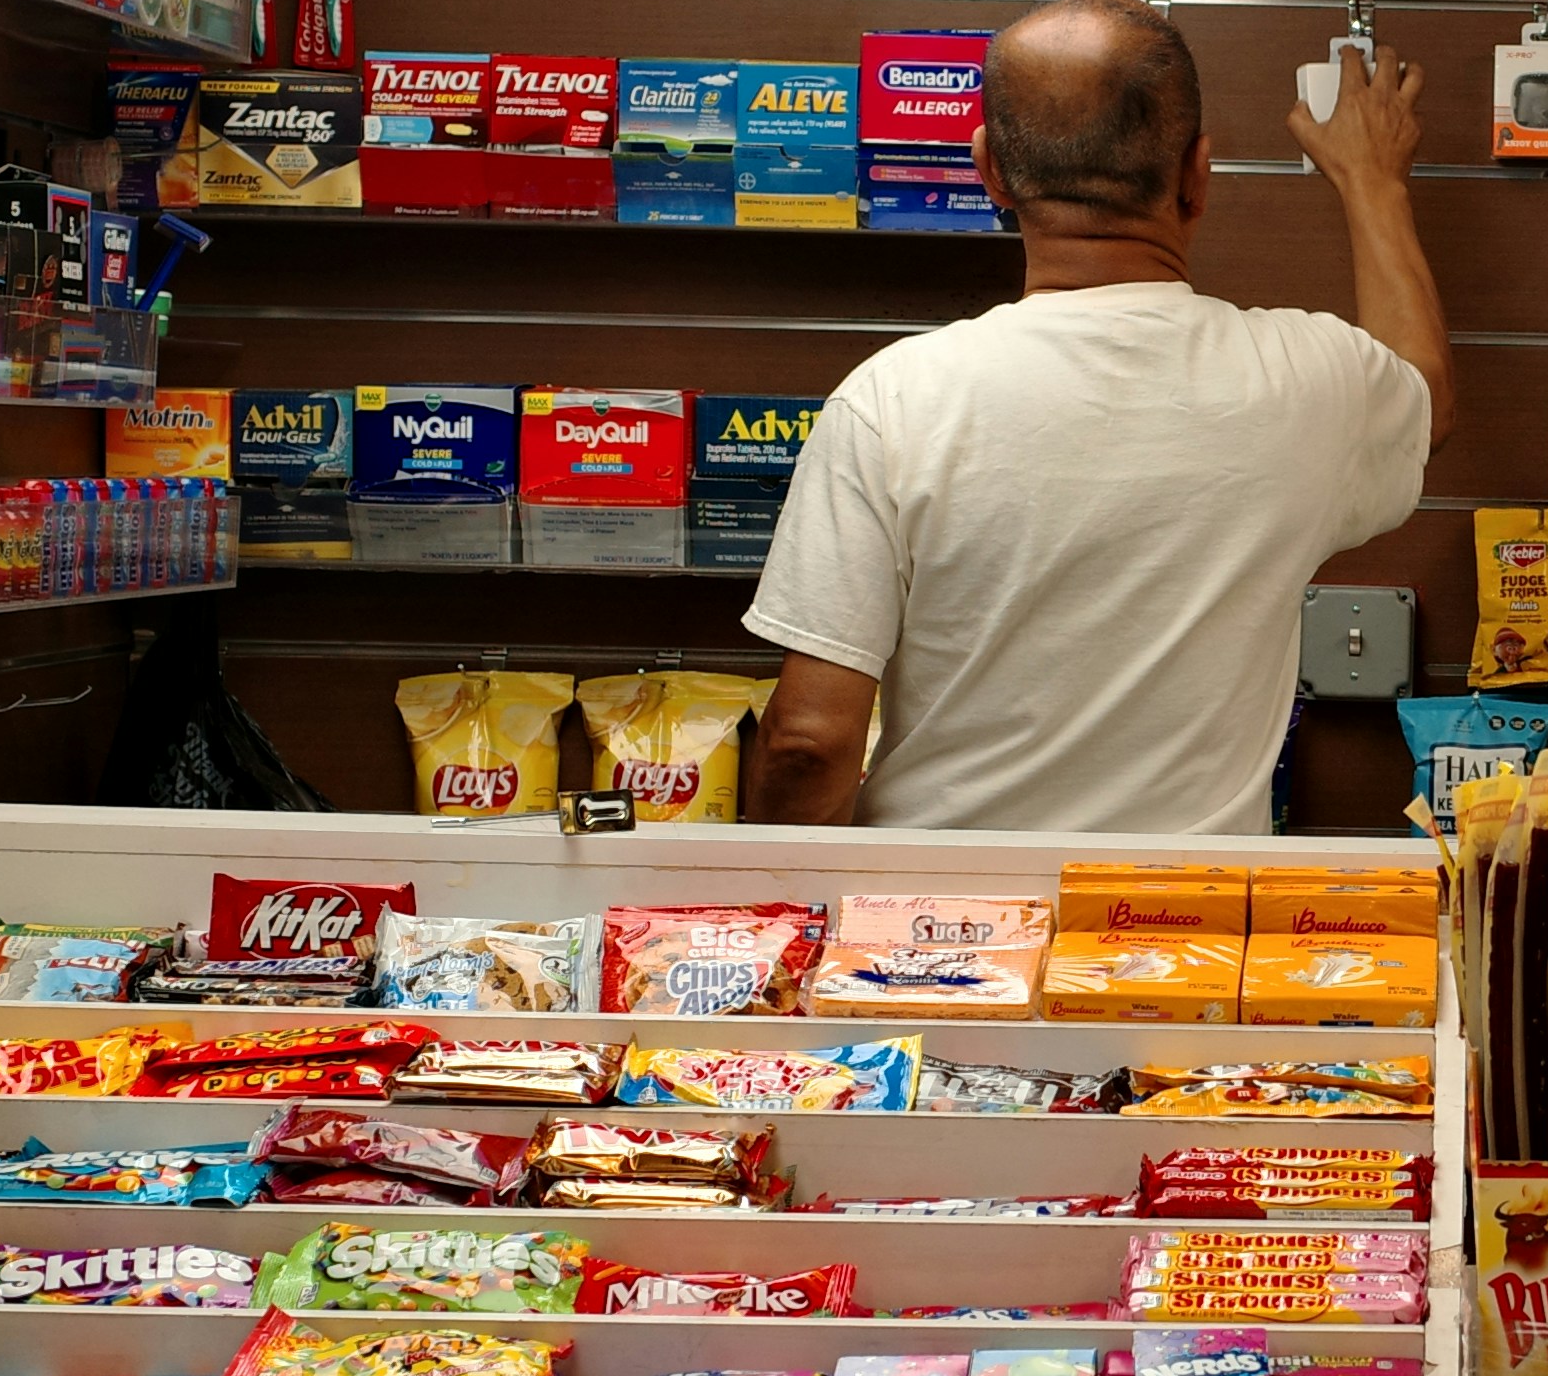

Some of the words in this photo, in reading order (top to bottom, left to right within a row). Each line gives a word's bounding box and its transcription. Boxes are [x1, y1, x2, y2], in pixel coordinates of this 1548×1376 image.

[371, 64, 482, 92] TYLENOL
[495, 63, 612, 96] TYLENOL
[888, 67, 976, 89] Benadryl
[629, 86, 697, 109] Claritin
[749, 83, 848, 114] ALEVE
[893, 100, 973, 117] ALLERGY
[222, 102, 336, 130] Zantac
[241, 404, 326, 430] Advil
[392, 415, 473, 443] NyQuil
[556, 419, 649, 447] DayQuil
[411, 448, 453, 460] SEVERE
[581, 453, 622, 464] SEVERE
[1500, 544, 1545, 562] Keebler
[1499, 588, 1548, 598] STRIPES
[1500, 575, 1545, 587] FUDGE
[1510, 601, 1538, 611] Minis
[437, 766, 514, 810] Lay's
[240, 893, 364, 949] KitKat
[1108, 898, 1202, 931] Bauducco
[1292, 908, 1388, 935] Bauducco
[912, 916, 994, 946] Sugar
[669, 960, 754, 997] Chips
[329, 1231, 560, 1287] Skittles
